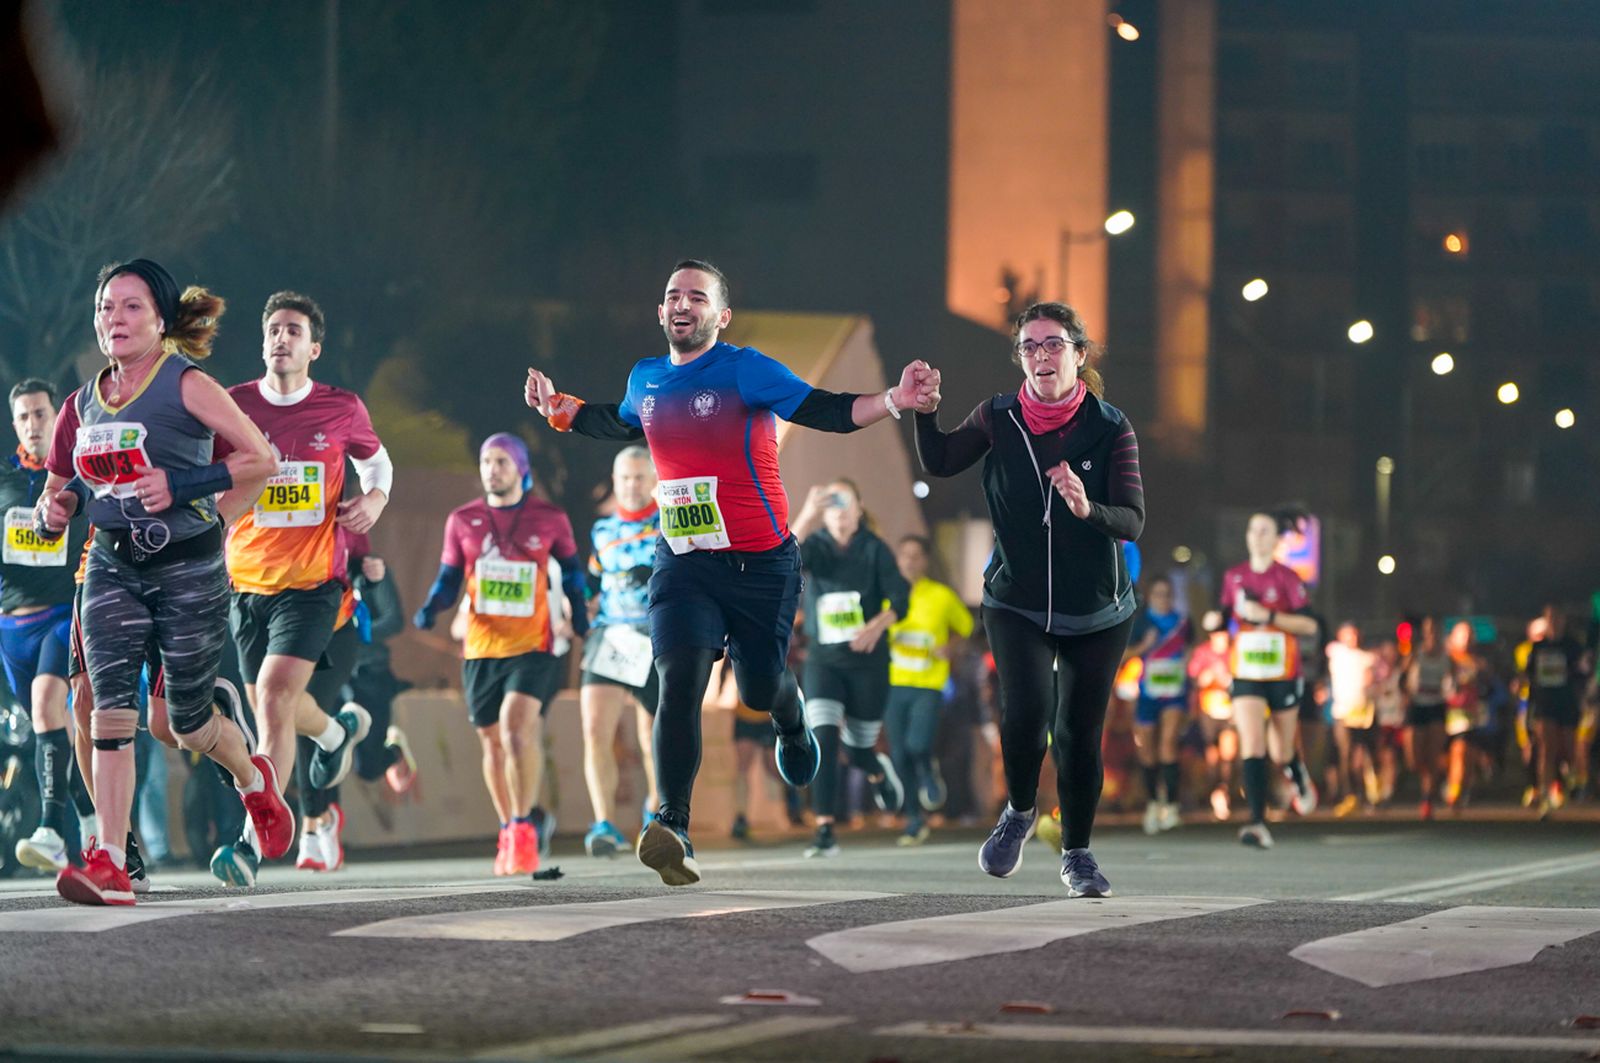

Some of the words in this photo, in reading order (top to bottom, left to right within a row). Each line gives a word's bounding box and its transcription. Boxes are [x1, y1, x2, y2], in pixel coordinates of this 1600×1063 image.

[267, 485, 311, 505] 7954
[665, 503, 715, 530] 12080
[488, 580, 523, 598] 2726
